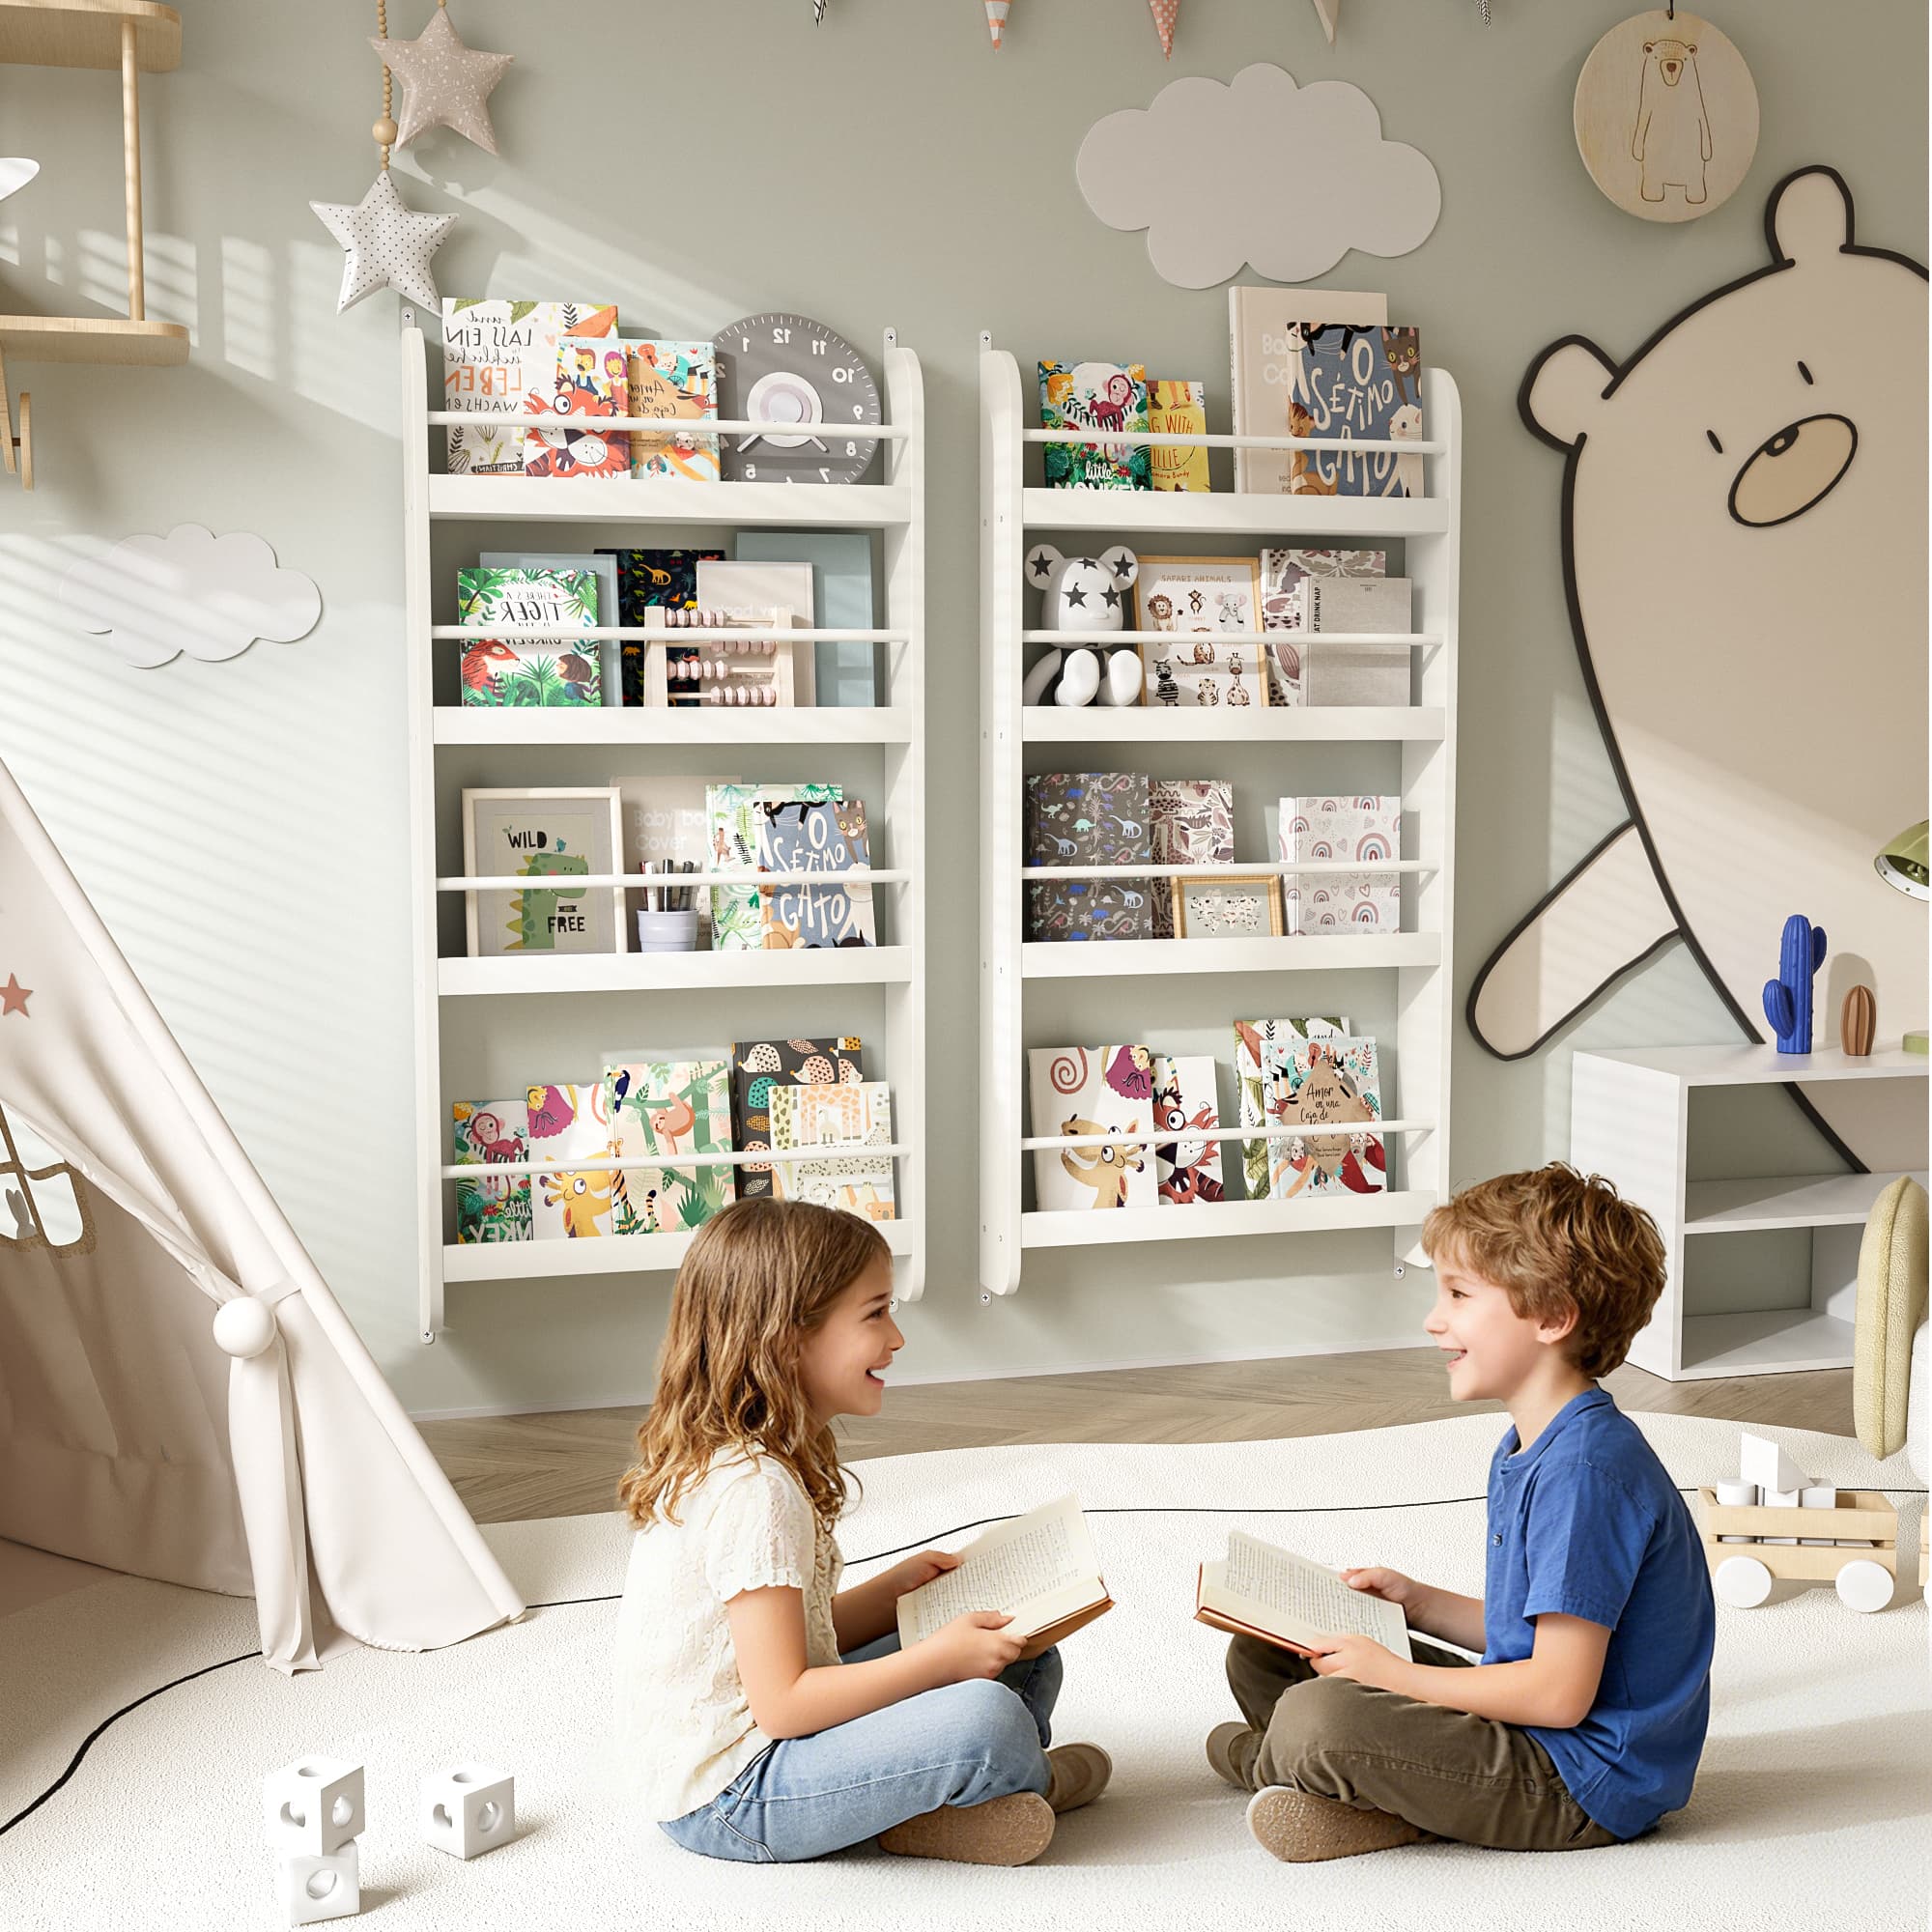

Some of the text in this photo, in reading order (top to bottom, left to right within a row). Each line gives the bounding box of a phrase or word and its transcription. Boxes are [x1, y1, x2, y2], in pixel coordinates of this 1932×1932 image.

[1352, 338, 1374, 386] O
[1165, 414, 1194, 434] WITH
[1152, 448, 1180, 469] ILLIE
[1085, 460, 1113, 480] little
[508, 831, 548, 849] WILD
[808, 811, 828, 850] O
[635, 834, 688, 851] Cover
[547, 916, 585, 934] FREE
